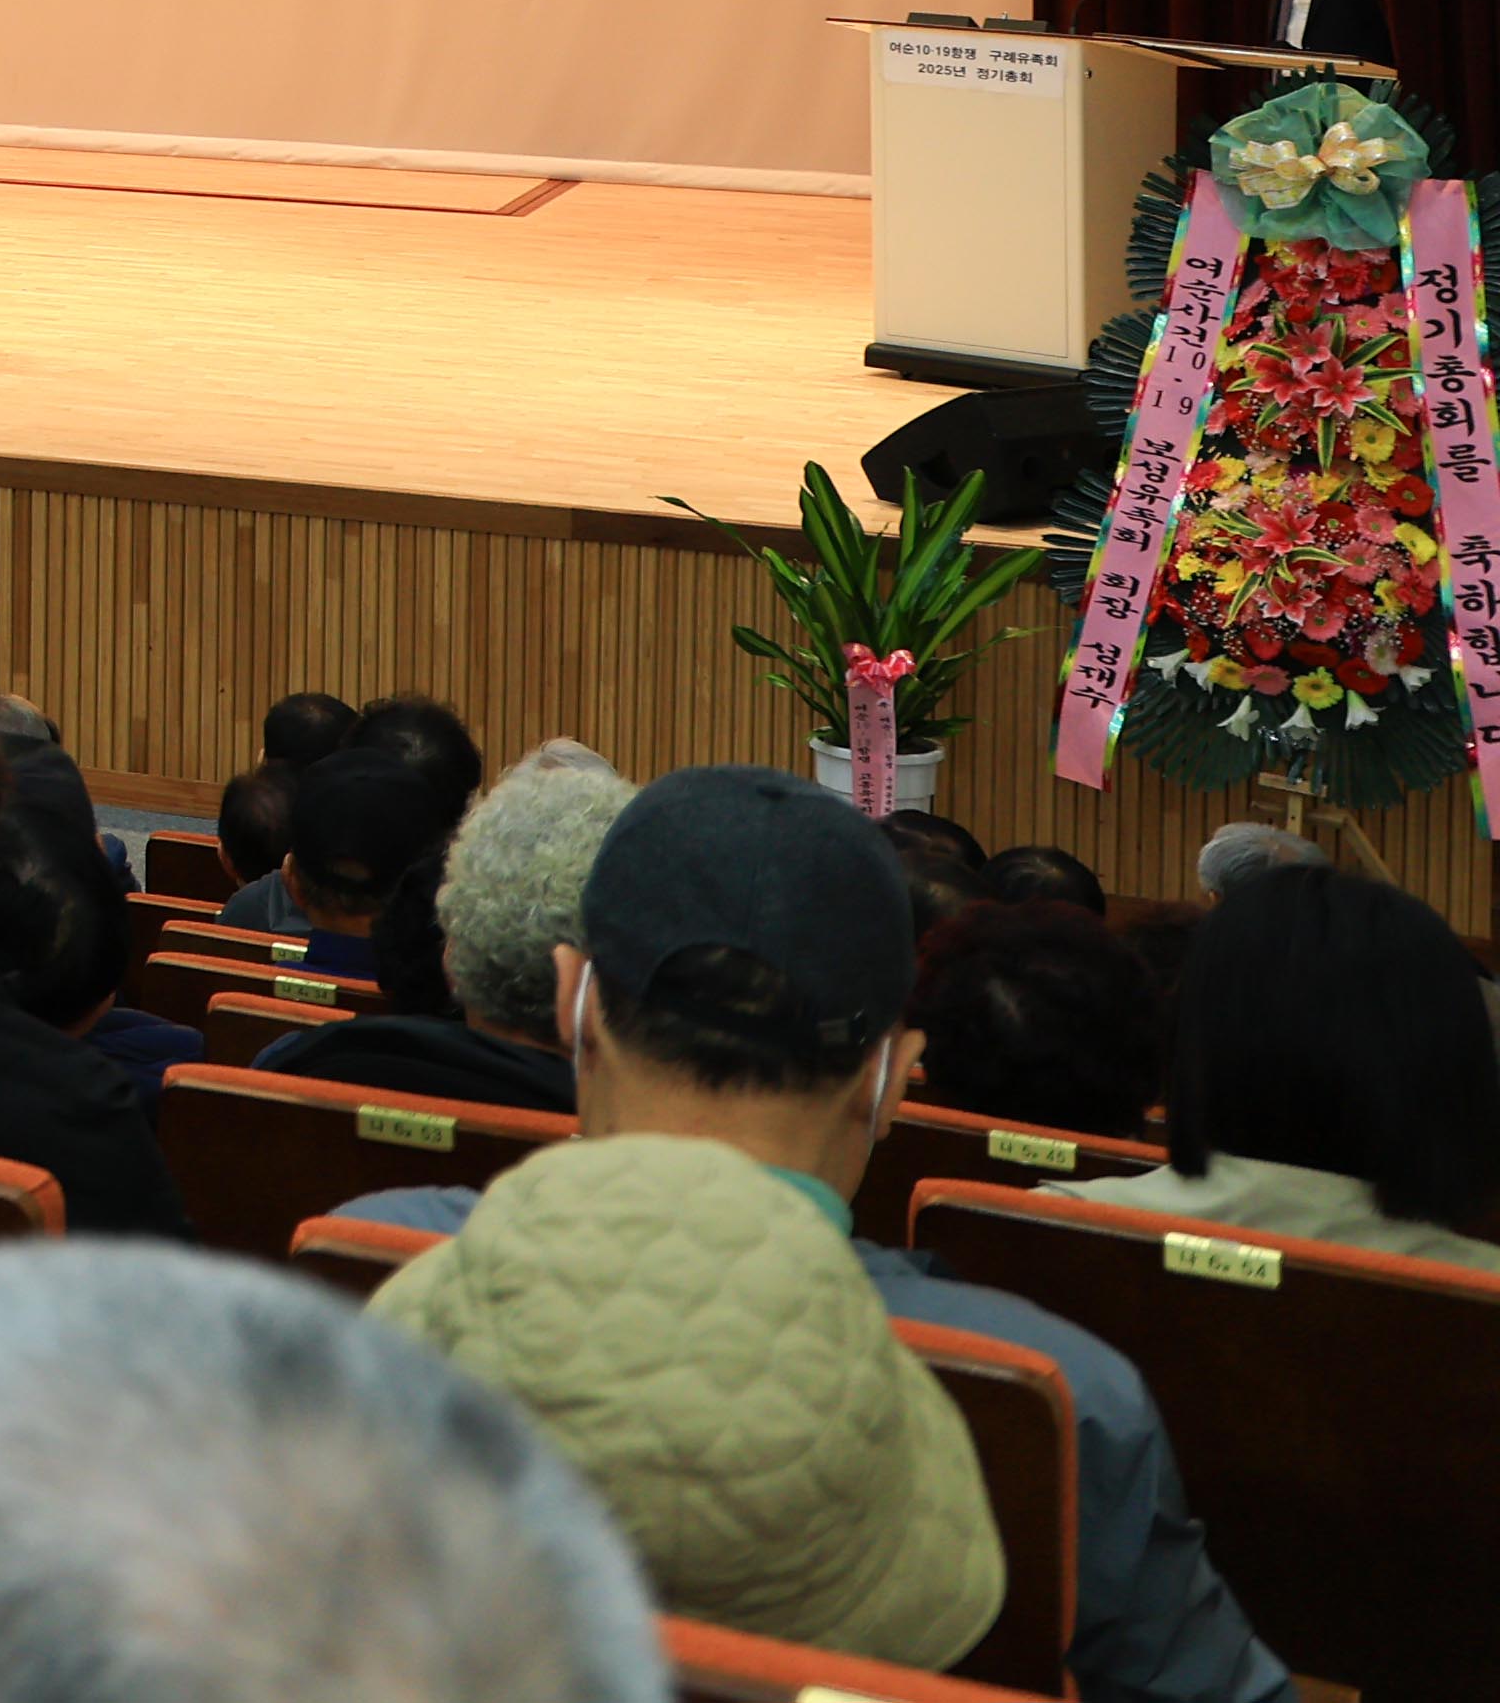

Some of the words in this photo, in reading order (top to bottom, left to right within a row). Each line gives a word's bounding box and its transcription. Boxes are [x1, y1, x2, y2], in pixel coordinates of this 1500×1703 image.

[918, 63, 966, 77] 2025년
[976, 67, 1033, 83] 정기총회
[989, 50, 1058, 67] 구례유족회
[1416, 264, 1492, 483] 정기총회를
[1112, 437, 1181, 552] 보성유족회
[1094, 572, 1141, 619] 회장
